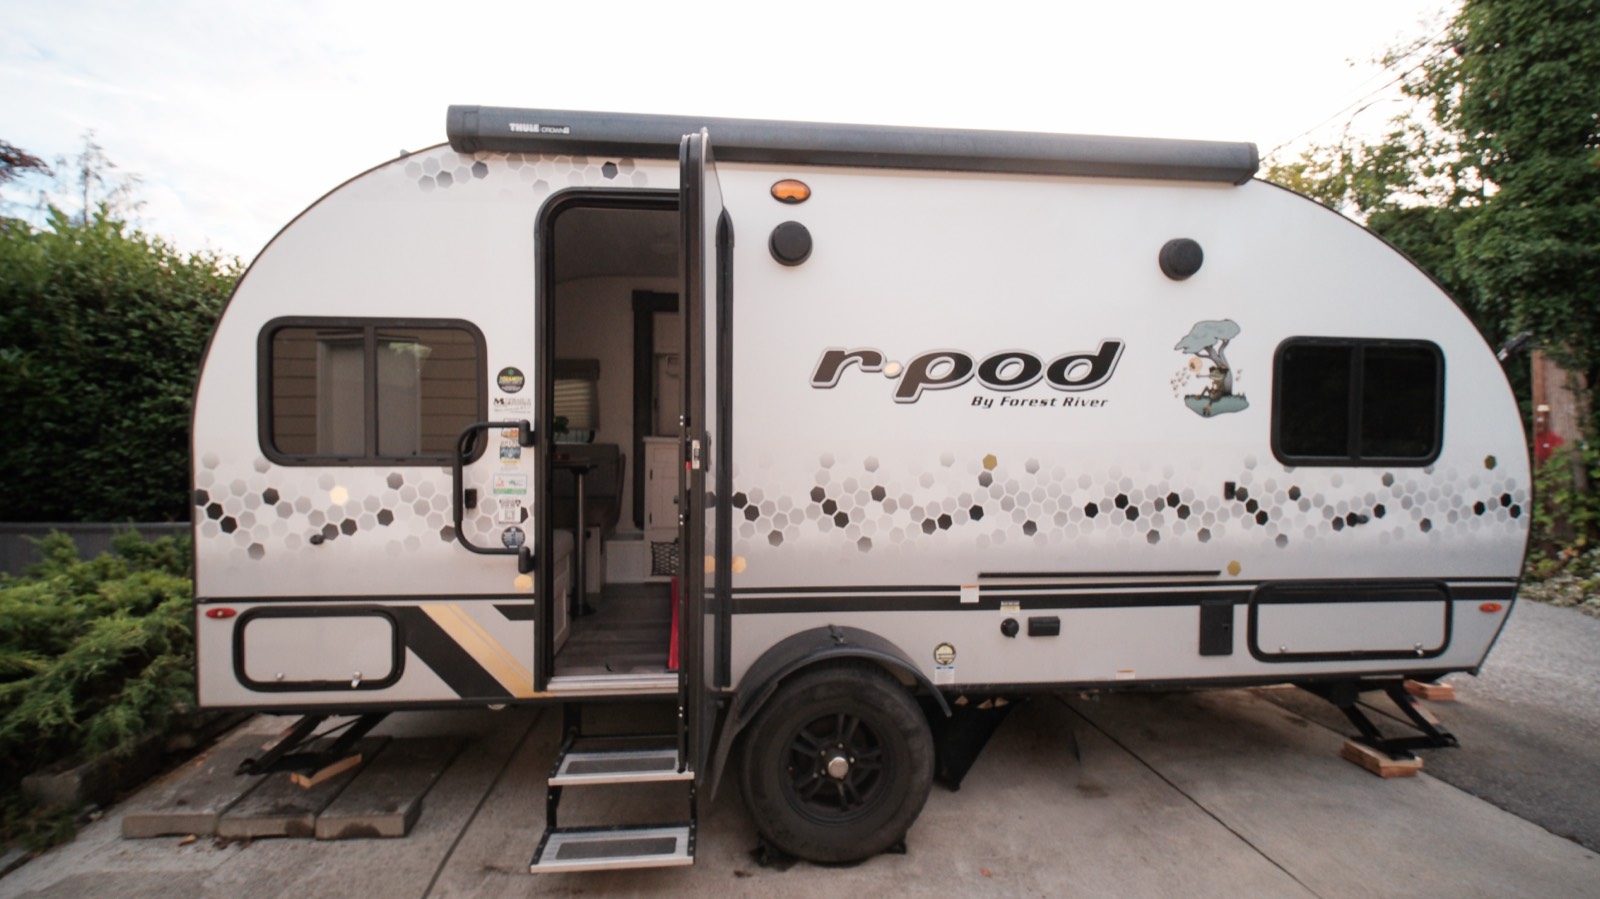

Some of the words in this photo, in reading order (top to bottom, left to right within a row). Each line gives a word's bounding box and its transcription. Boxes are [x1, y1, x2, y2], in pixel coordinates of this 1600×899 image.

[509, 123, 540, 132] THULE
[971, 395, 993, 408] By
[1000, 395, 1058, 407] Forest
[1062, 396, 1108, 408] River
